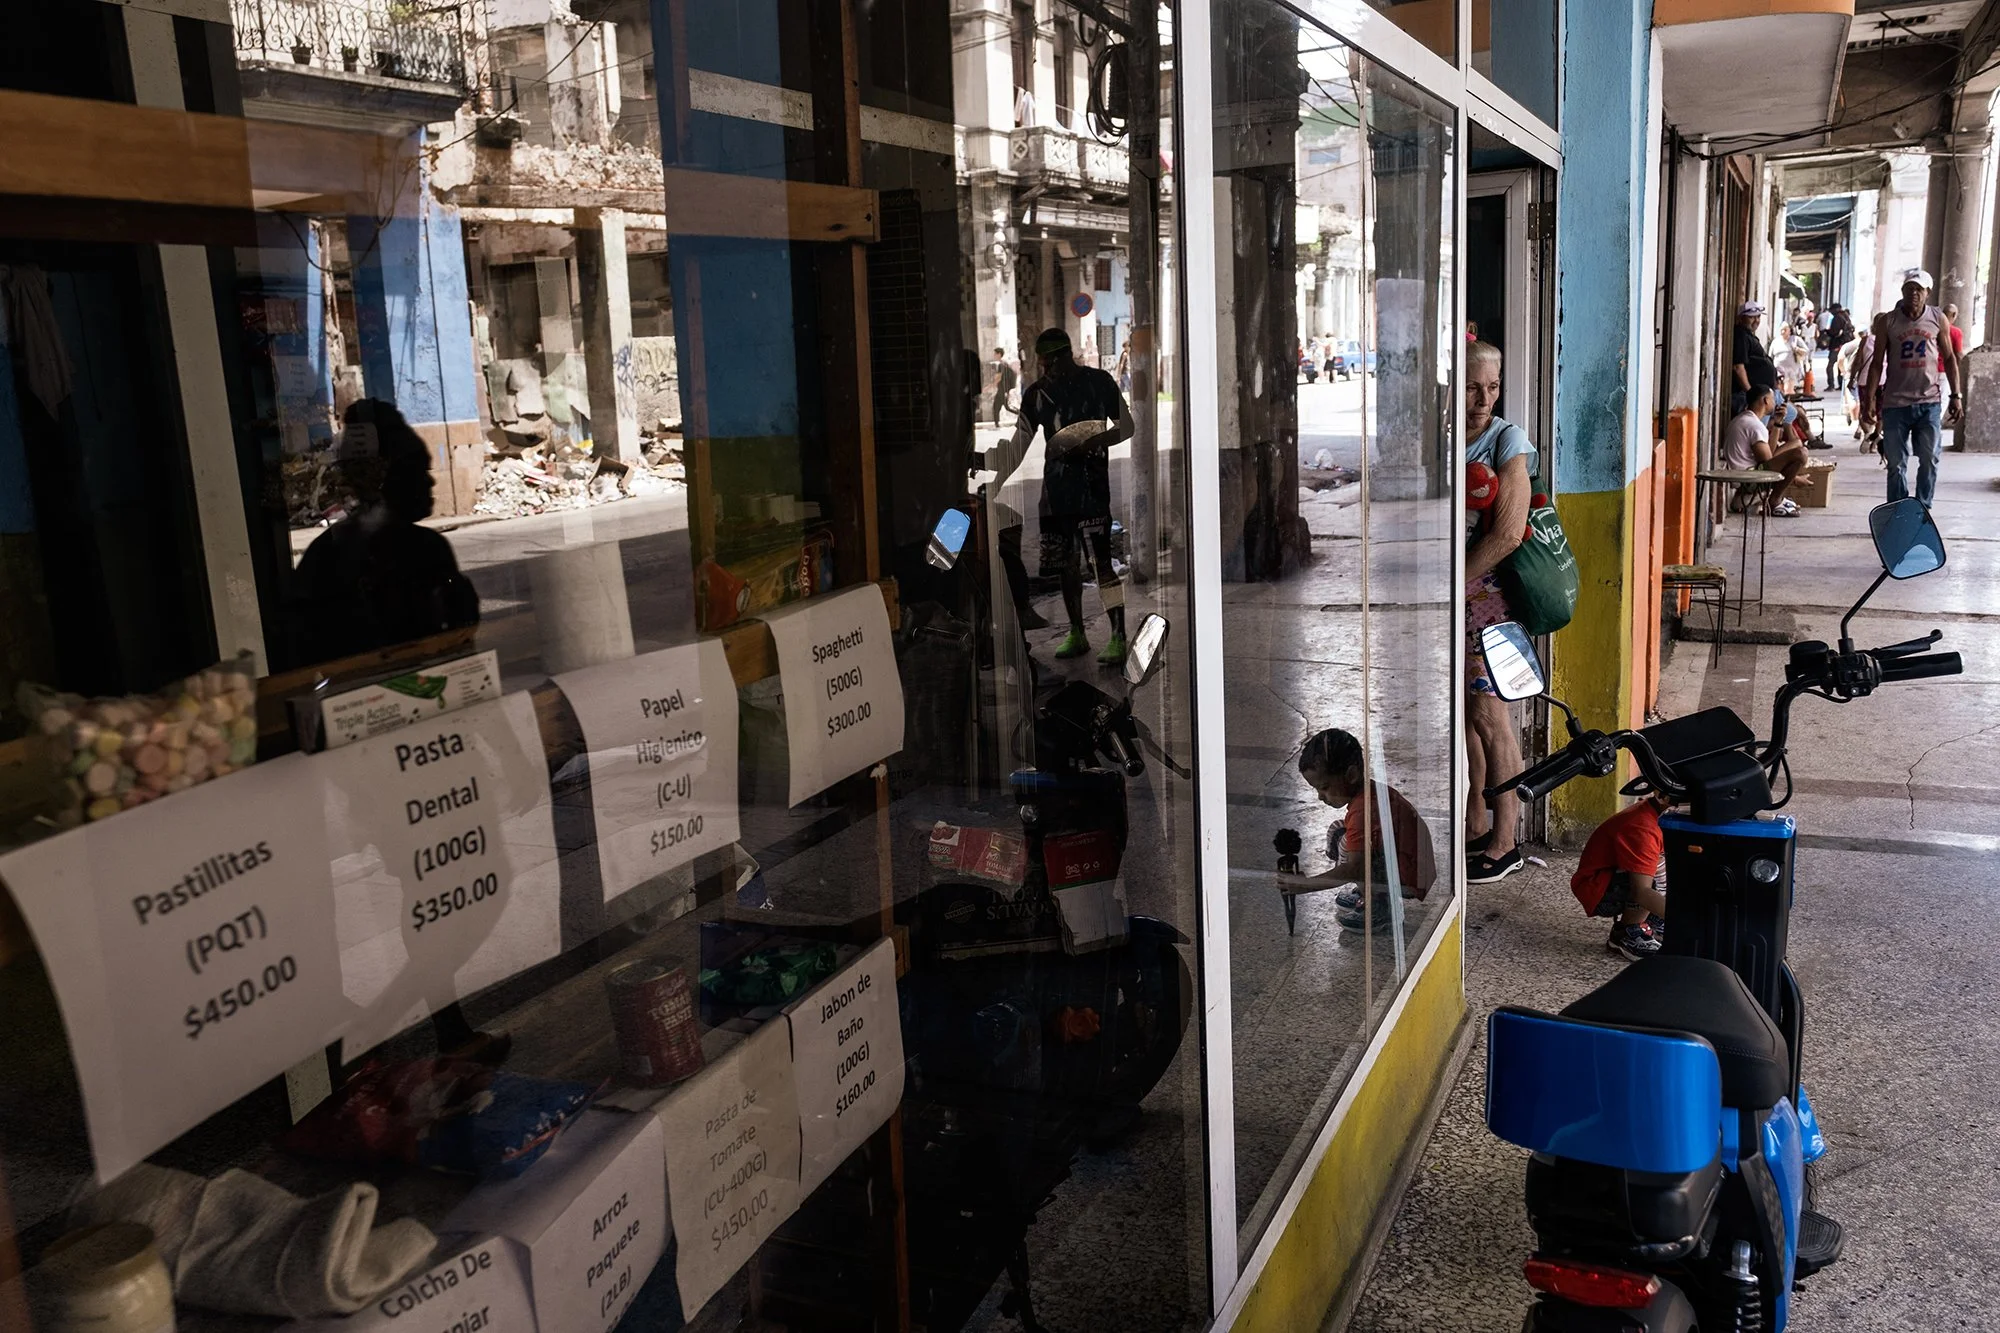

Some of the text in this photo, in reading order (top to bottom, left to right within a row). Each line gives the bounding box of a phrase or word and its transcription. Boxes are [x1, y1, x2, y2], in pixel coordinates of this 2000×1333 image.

[1901, 340, 1926, 359] 24
[812, 626, 864, 664] Spaghetti
[640, 688, 685, 719] Papel
[826, 666, 863, 700] (500G)
[827, 702, 871, 739] $300.00
[395, 733, 465, 772] Pasta
[636, 729, 703, 764] Higienico
[406, 776, 480, 825] Dental
[657, 773, 692, 809] (C-U)
[414, 826, 486, 881] (100G)
[651, 815, 703, 856] $150.00
[131, 840, 273, 925] Pastillitas
[412, 872, 498, 932] $350.00
[185, 905, 268, 974] (PQT)
[183, 955, 298, 1040] $450.00
[821, 974, 872, 1024] Jabon de
[837, 1016, 864, 1047] Baño
[836, 1041, 870, 1085] (100G)
[705, 1090, 758, 1139] Pasta de
[836, 1070, 876, 1119] $160.00
[710, 1125, 757, 1172] Tomate
[704, 1150, 767, 1220] (CU-400G)
[593, 1191, 629, 1241] Arroz
[711, 1189, 769, 1252] $450.00
[587, 1219, 640, 1289] Paquete
[379, 1250, 492, 1319] Colcha De
[601, 1264, 632, 1319] (2LB)
